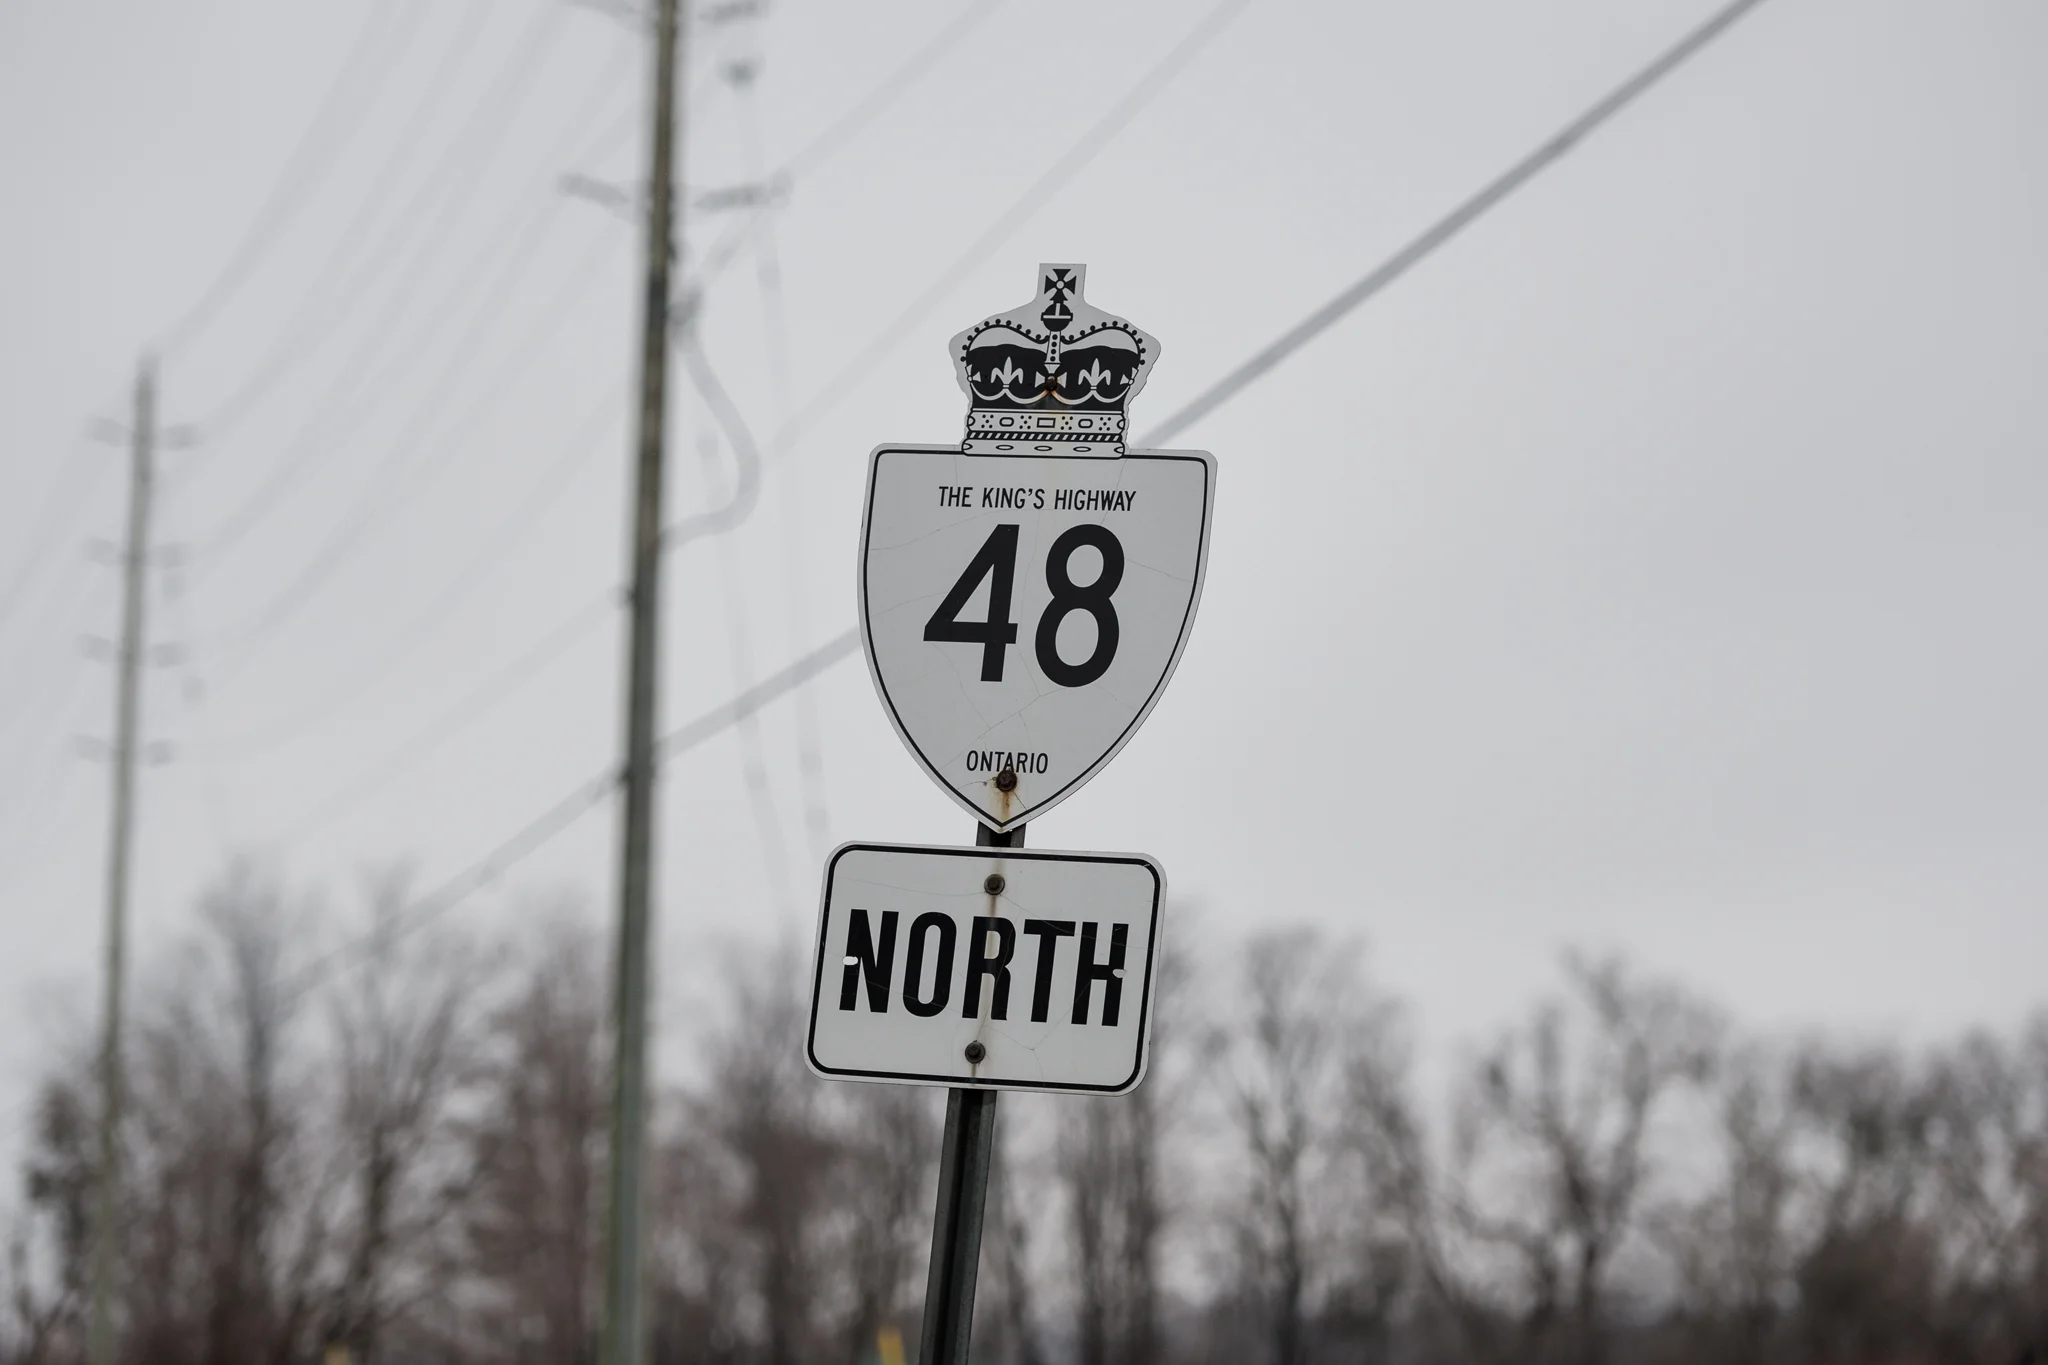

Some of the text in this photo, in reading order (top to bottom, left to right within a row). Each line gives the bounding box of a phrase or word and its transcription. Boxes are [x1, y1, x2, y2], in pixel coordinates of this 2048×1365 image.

[939, 486, 1136, 511] THE KING'S HIGHWAY
[923, 523, 1125, 688] 48
[966, 750, 1049, 774] ONTARIO
[839, 908, 1129, 1027] NORTH
